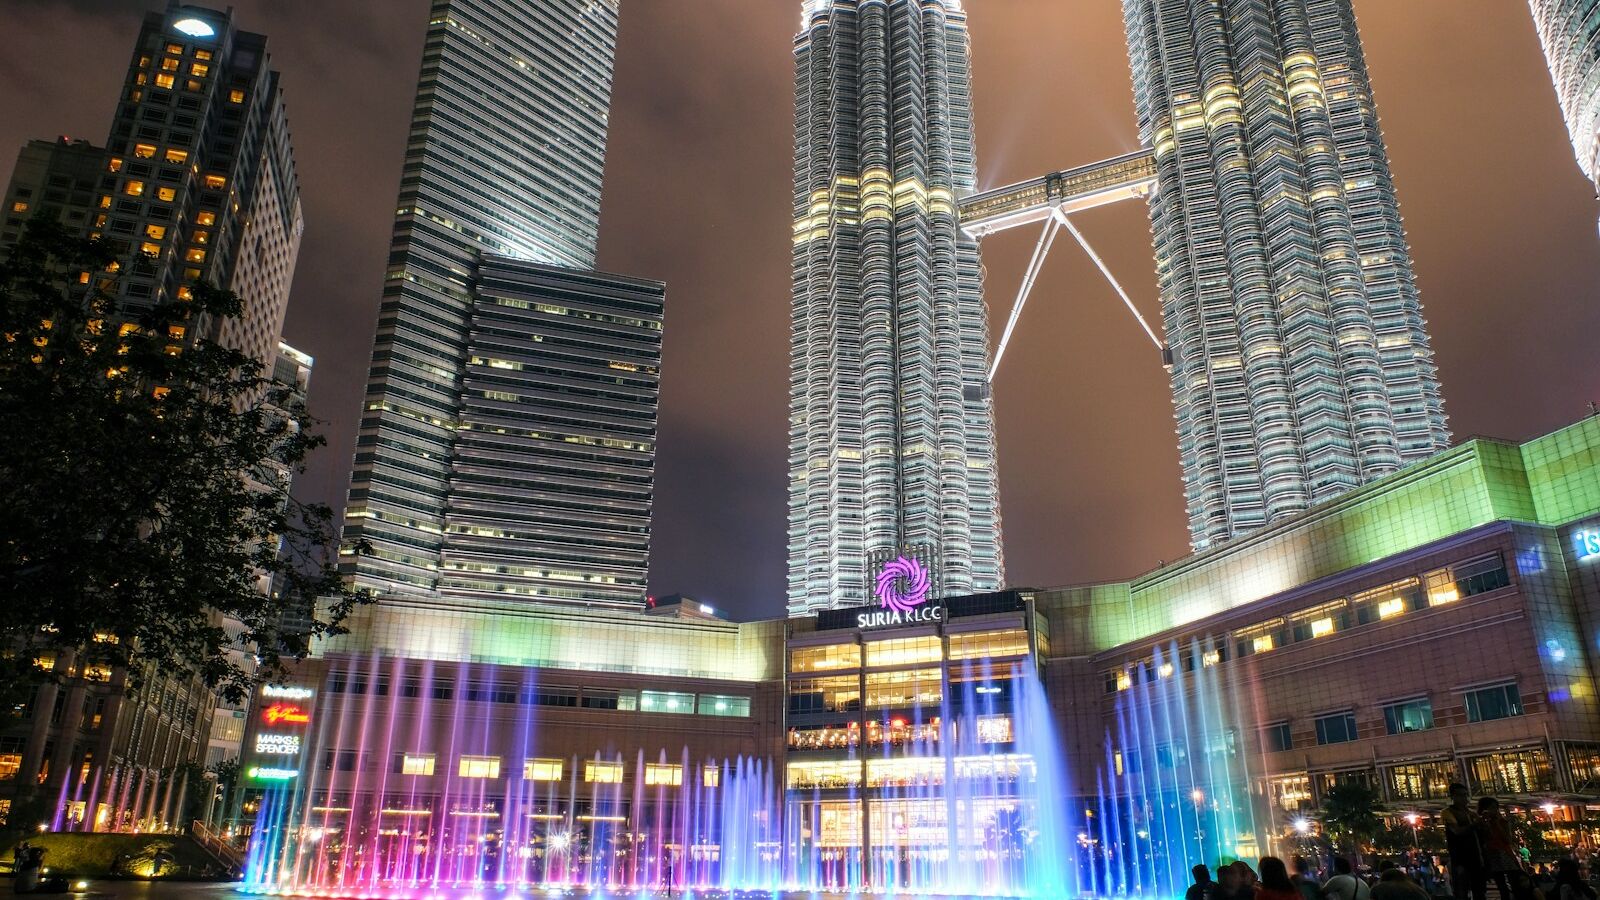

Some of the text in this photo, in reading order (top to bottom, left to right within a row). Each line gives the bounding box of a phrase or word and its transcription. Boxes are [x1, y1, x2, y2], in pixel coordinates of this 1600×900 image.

[857, 606, 941, 628] SURIA KLCC
[257, 735, 299, 745] MARKS &
[256, 744, 299, 754] SPENCER
